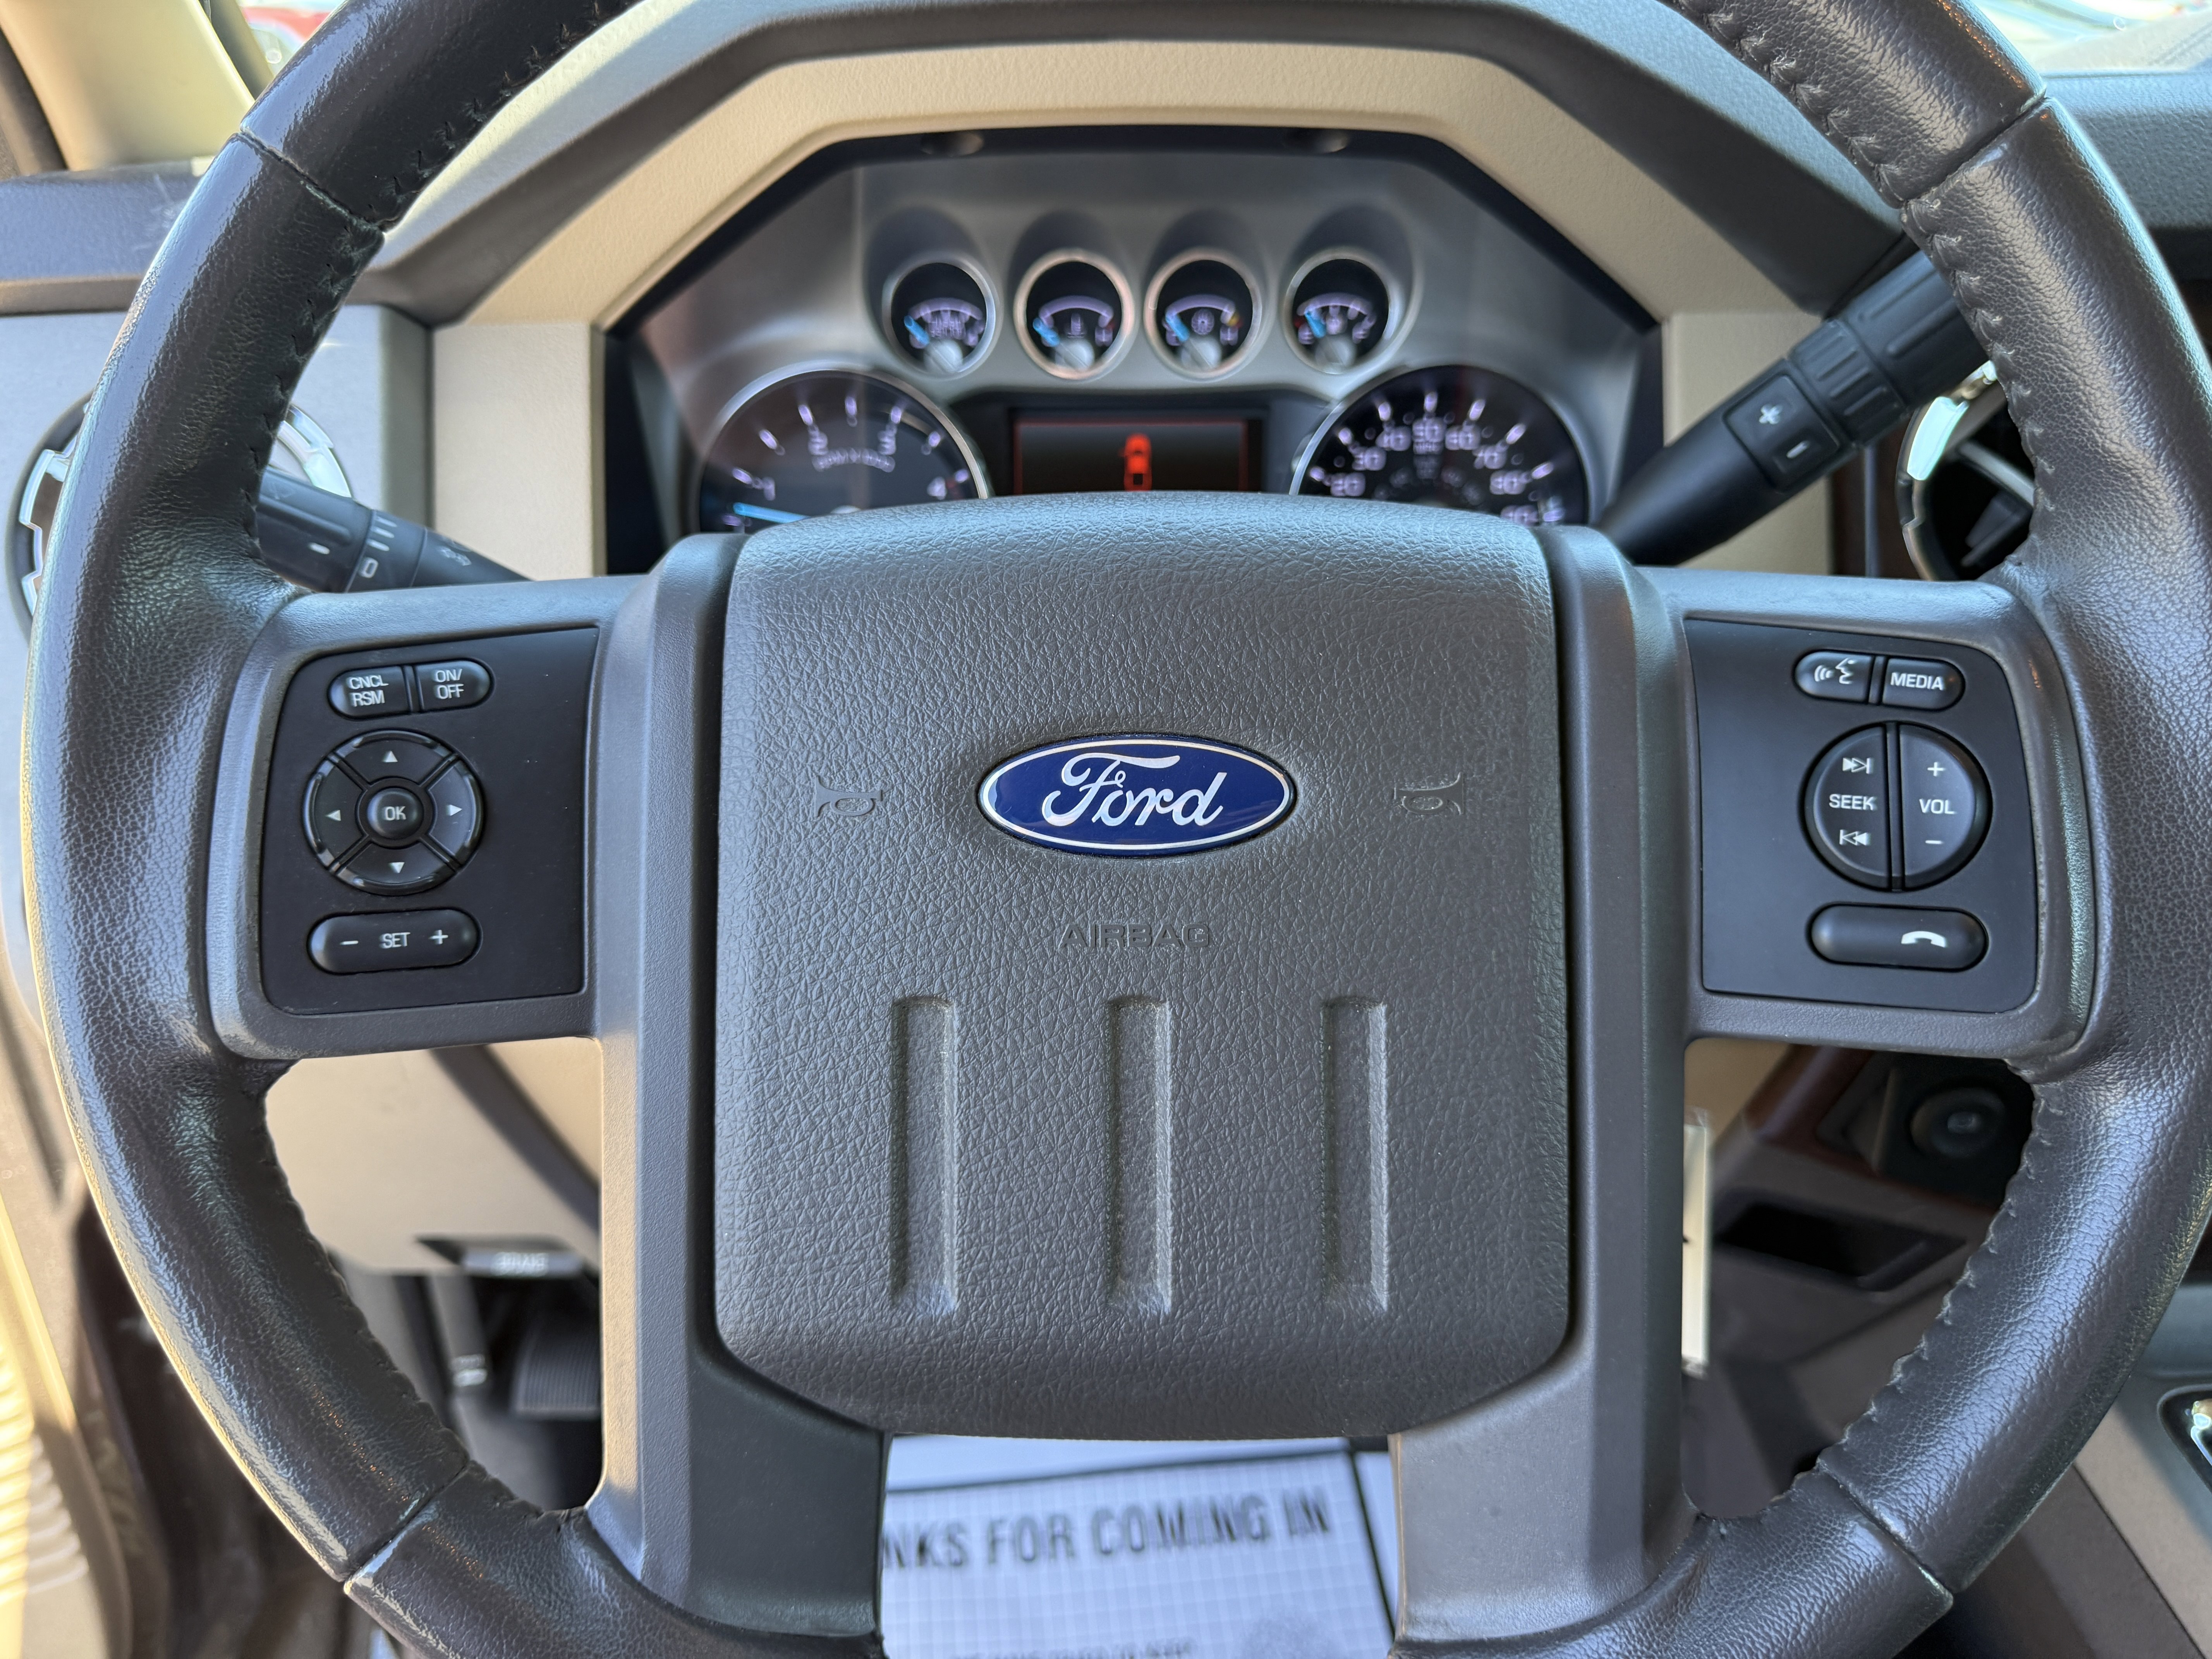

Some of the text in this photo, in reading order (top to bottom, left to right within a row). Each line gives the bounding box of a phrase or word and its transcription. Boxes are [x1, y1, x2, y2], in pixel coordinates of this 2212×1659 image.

[1376, 427, 1411, 451] 40
[1413, 418, 1446, 443] 50
[1445, 427, 1480, 450] 60
[1353, 447, 1386, 471] 30
[348, 675, 389, 690] CNCL
[434, 668, 463, 683] ON/
[1890, 672, 1944, 690] MEDIA
[352, 690, 385, 707] RSM
[436, 684, 464, 699] OFF
[1042, 753, 1227, 826] Ford
[1828, 794, 1877, 811] SEEK
[1918, 799, 1956, 814] VOL
[384, 806, 407, 821] OK
[380, 932, 410, 949] SET
[1059, 924, 1211, 949] AIRBAG
[988, 1512, 1076, 1564] FOR
[1090, 1496, 1269, 1553] COMING
[1282, 1486, 1331, 1537] IN
